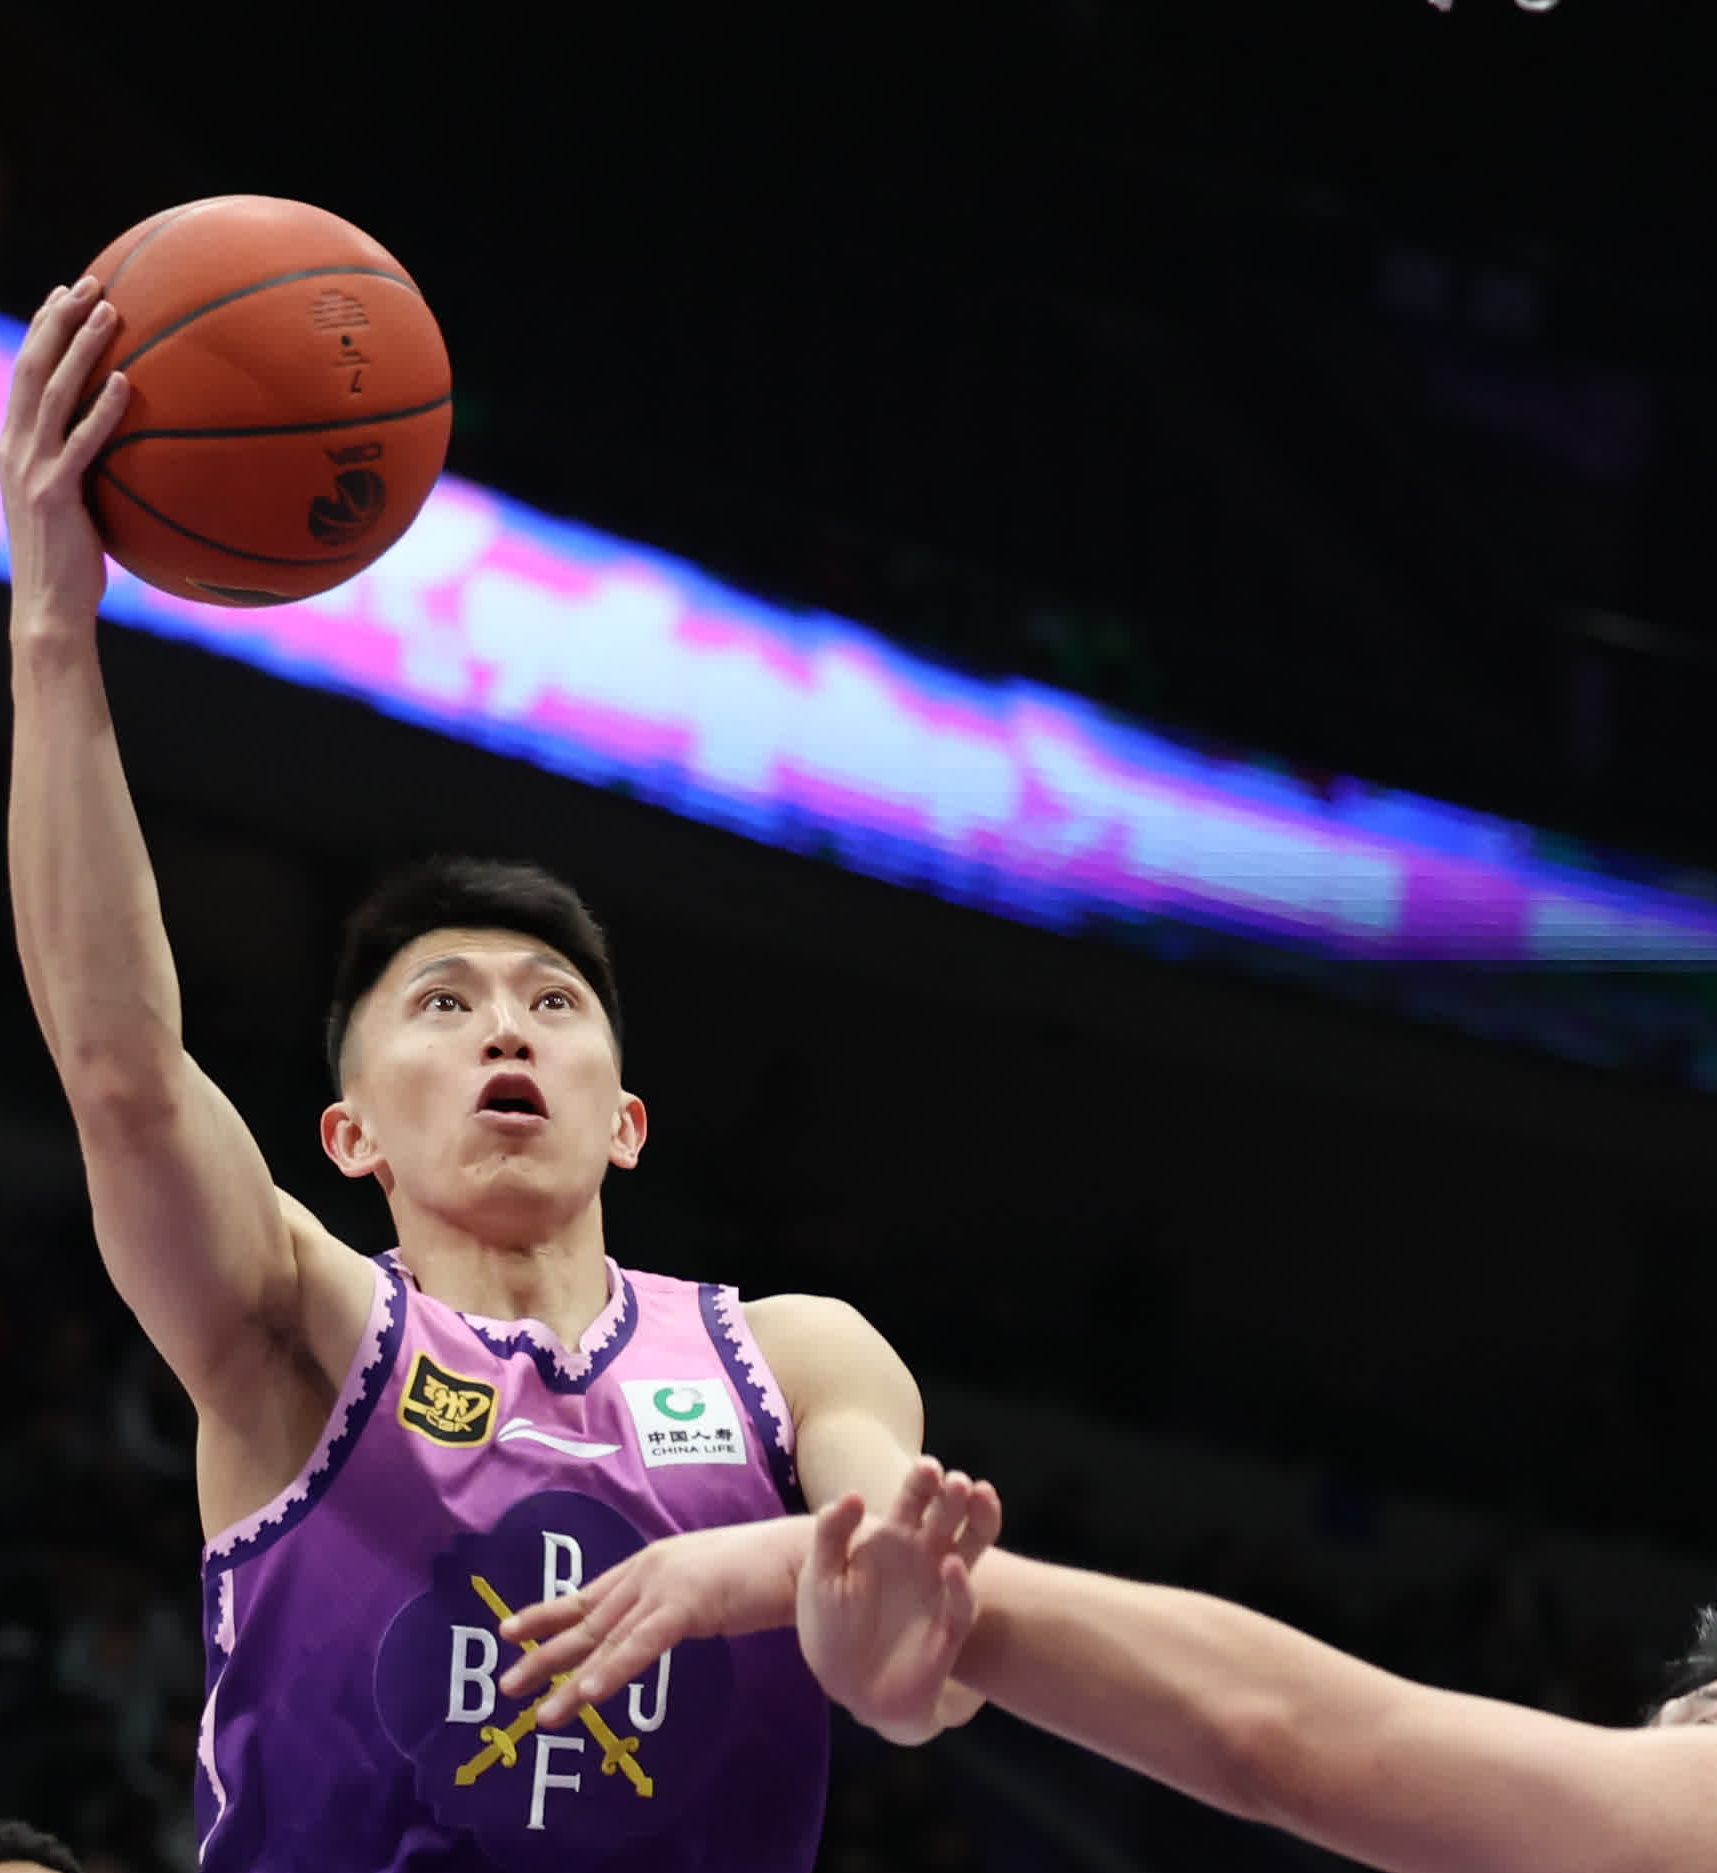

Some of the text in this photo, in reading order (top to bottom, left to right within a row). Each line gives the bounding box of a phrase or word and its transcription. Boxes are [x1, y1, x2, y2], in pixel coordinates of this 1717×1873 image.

[648, 1428, 732, 1444] 中国人寿
[652, 1445, 737, 1456] CHINA LIFE
[445, 1625, 498, 1725] B
[525, 1735, 585, 1831] F
